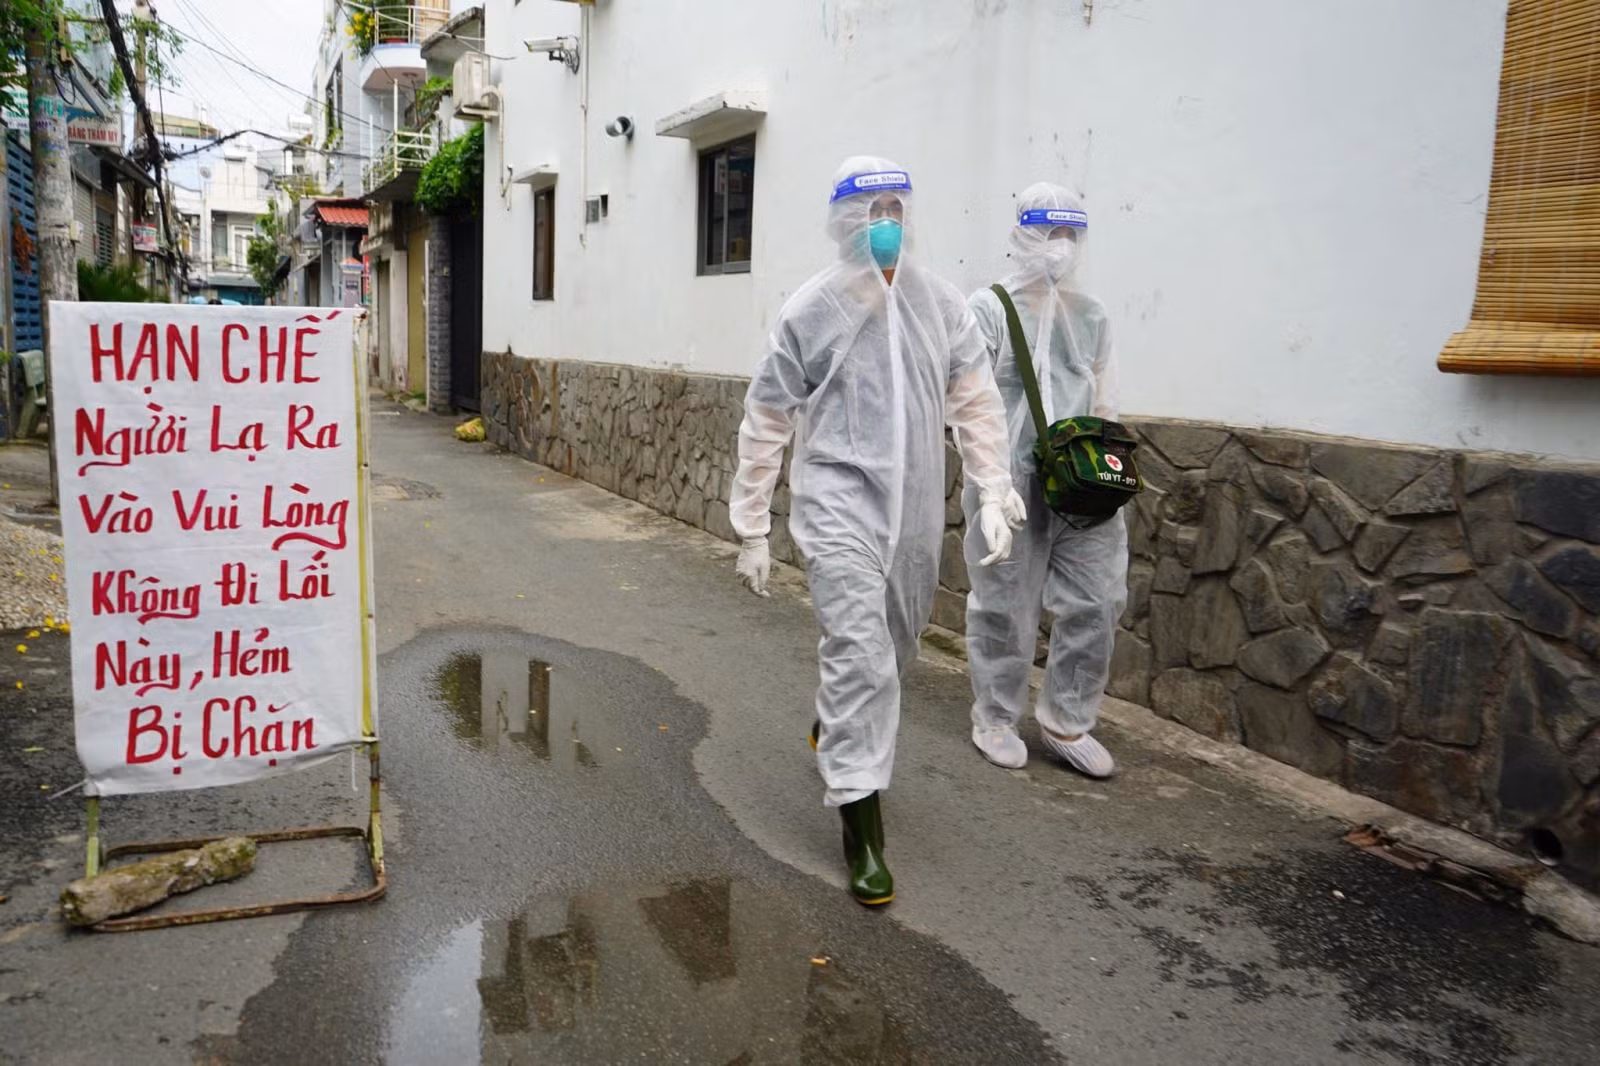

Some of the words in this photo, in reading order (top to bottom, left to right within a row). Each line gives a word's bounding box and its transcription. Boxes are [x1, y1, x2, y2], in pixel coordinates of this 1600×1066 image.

[858, 177, 879, 186] Face
[90, 323, 200, 394] HẠN
[222, 310, 340, 384] CHẾ
[76, 402, 187, 478] Người
[210, 404, 269, 462] Lạ
[286, 404, 341, 450] Ra
[78, 492, 152, 534] Vào
[172, 488, 241, 532] Vui
[262, 484, 350, 552] Lòng
[92, 570, 200, 624] Không
[214, 562, 258, 608] Đi
[278, 550, 334, 602] Lối
[126, 704, 187, 774] Bị
[202, 696, 319, 766] Chặn
